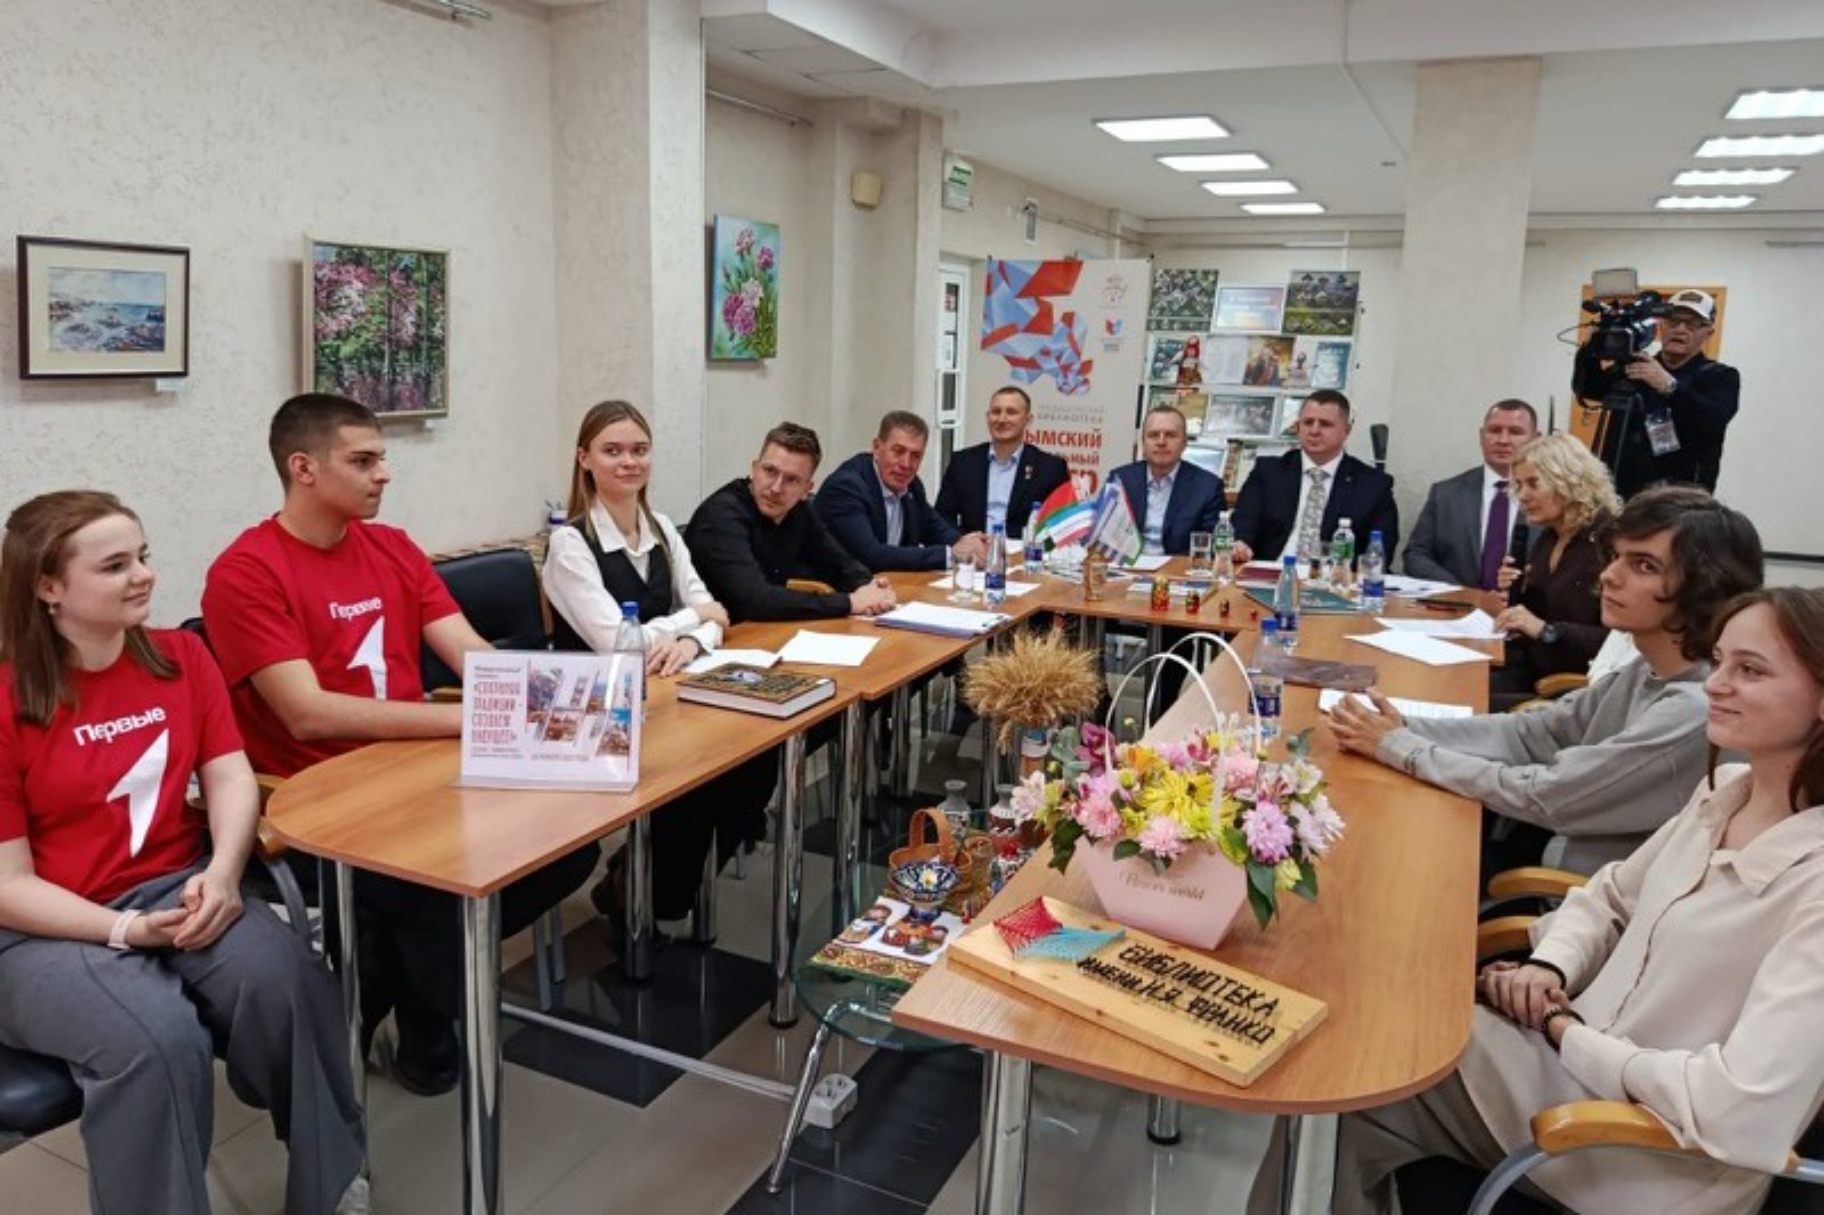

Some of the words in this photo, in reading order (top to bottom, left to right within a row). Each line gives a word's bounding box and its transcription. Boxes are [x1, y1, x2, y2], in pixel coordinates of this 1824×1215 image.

[1025, 428, 1102, 447] ЫМСКИЙ
[73, 706, 167, 746] Первые
[1119, 943, 1280, 1018] БИБЛИОТЕКА
